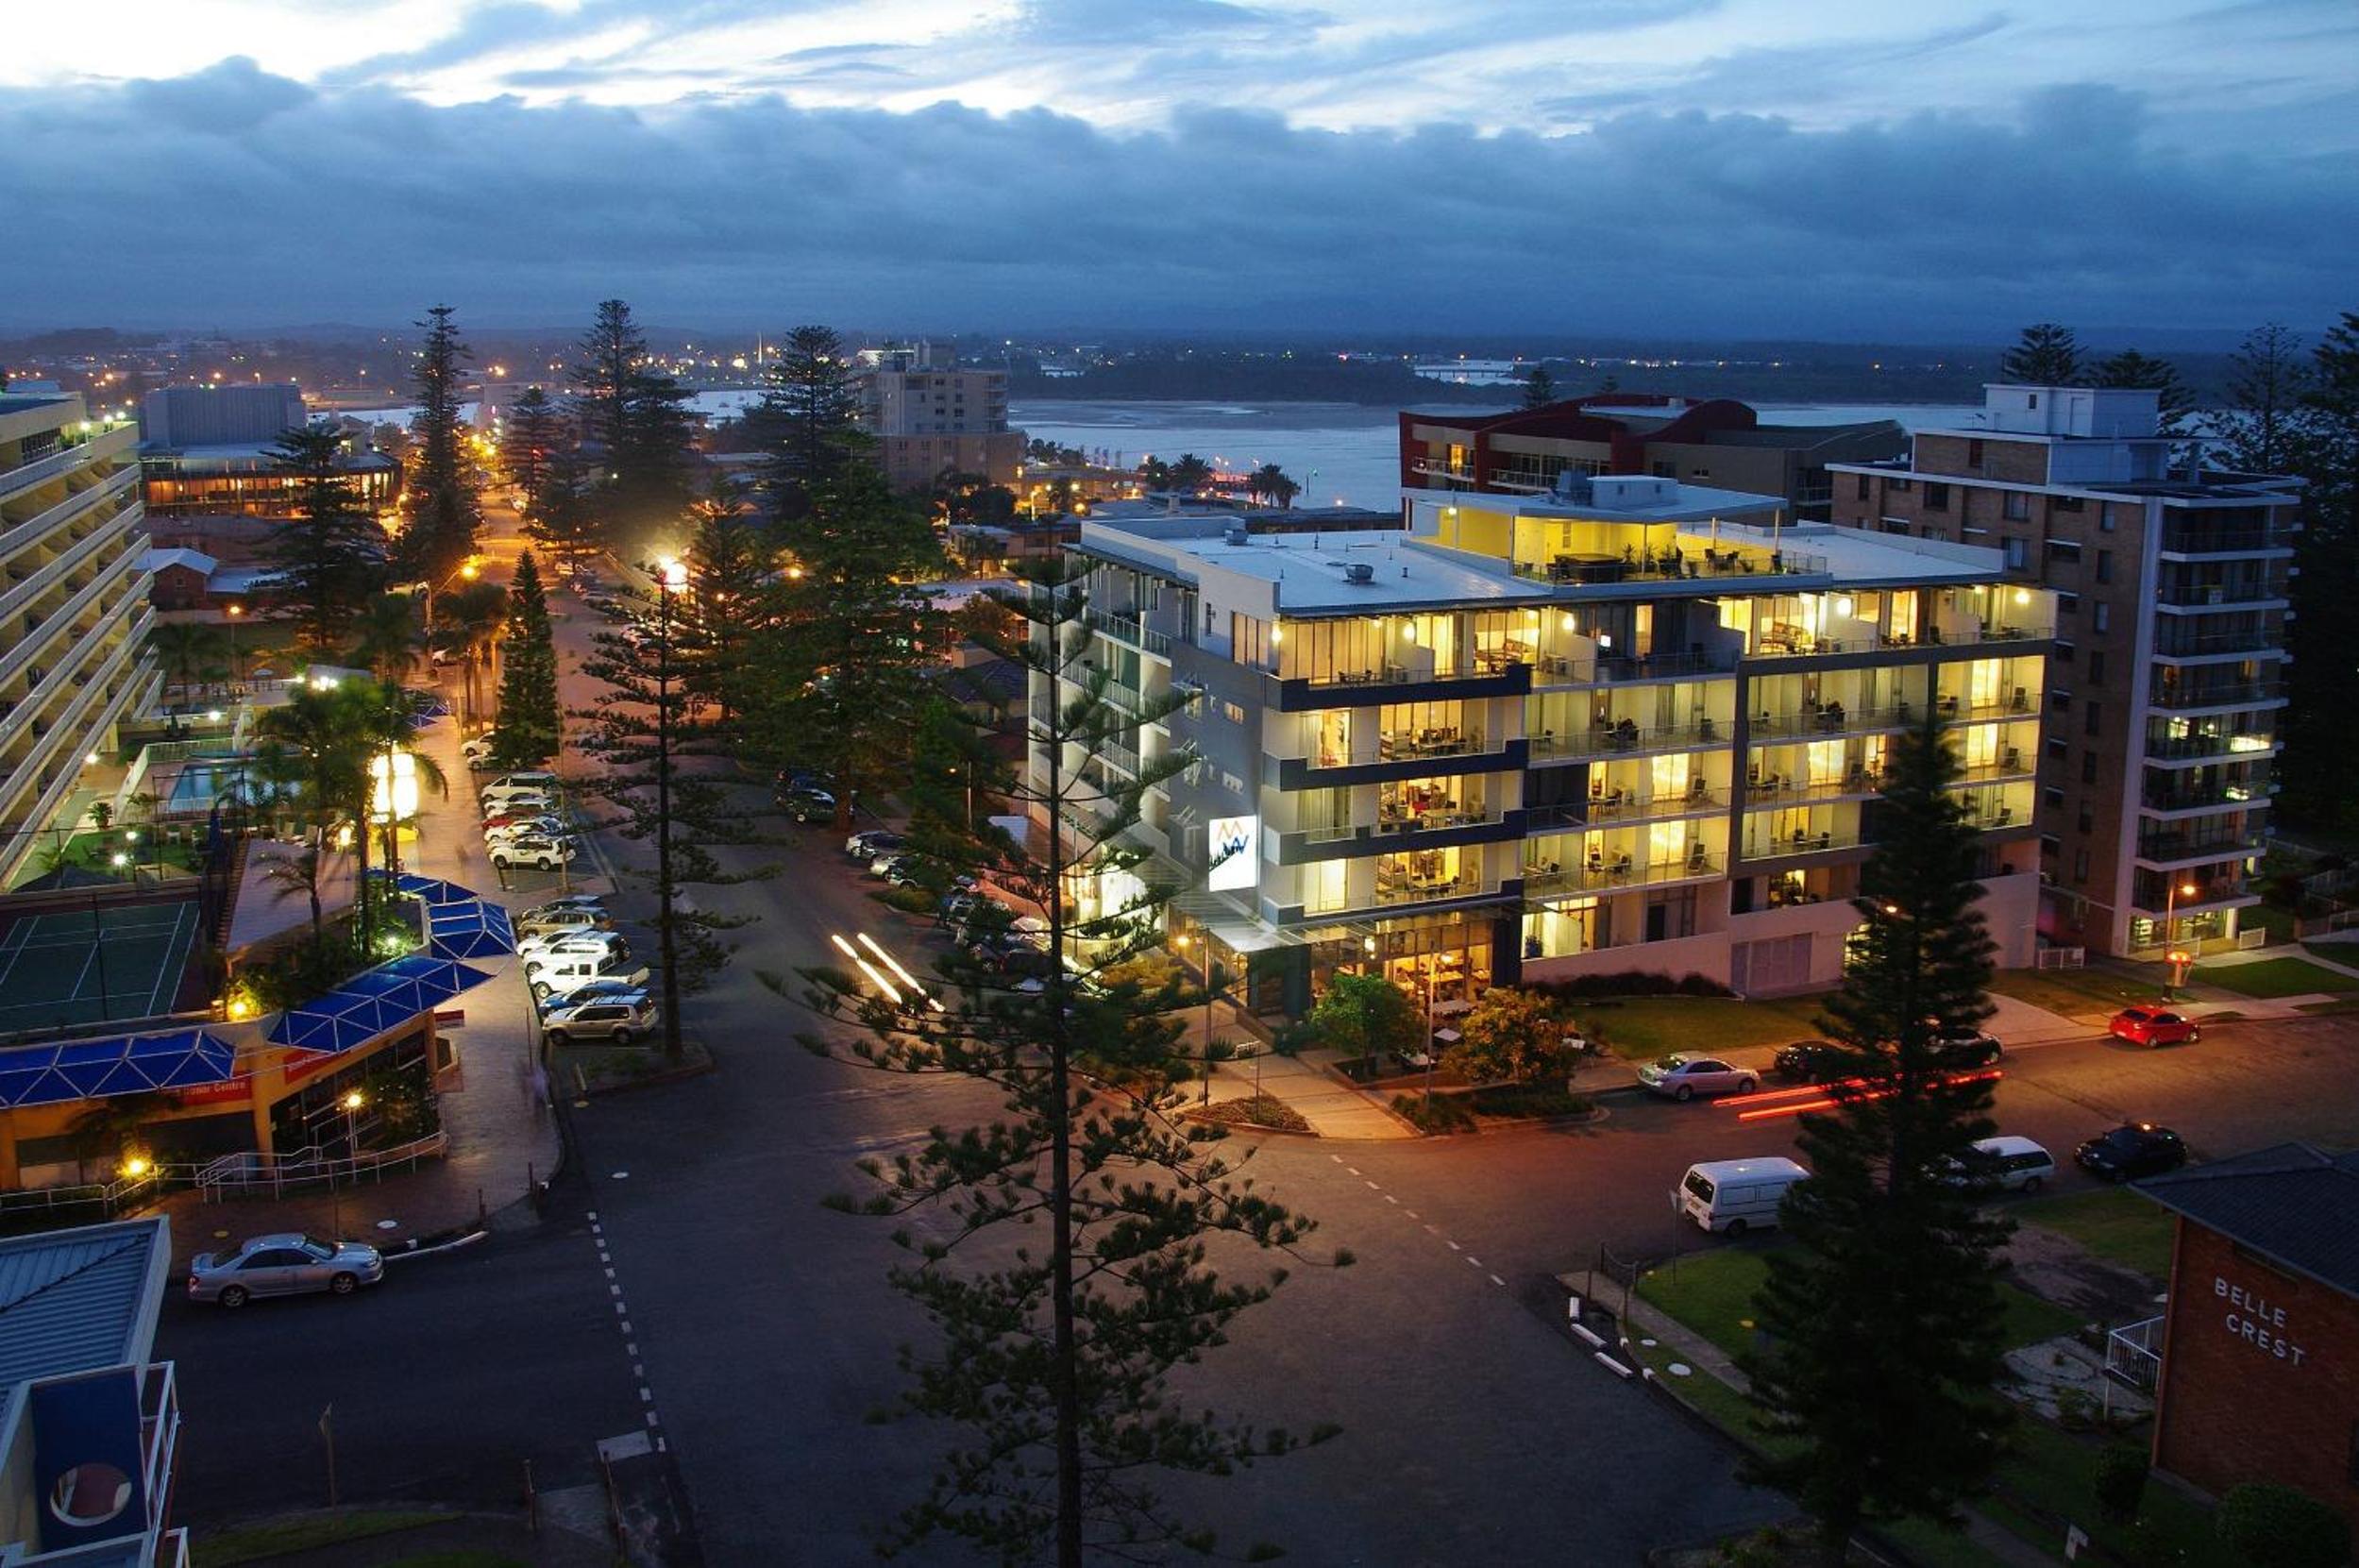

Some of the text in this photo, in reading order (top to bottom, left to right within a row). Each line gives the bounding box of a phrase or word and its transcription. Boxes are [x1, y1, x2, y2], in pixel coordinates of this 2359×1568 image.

[213, 1081, 246, 1093] Centre
[2215, 1275, 2286, 1328] BELLE
[2226, 1313, 2305, 1367] CREST
